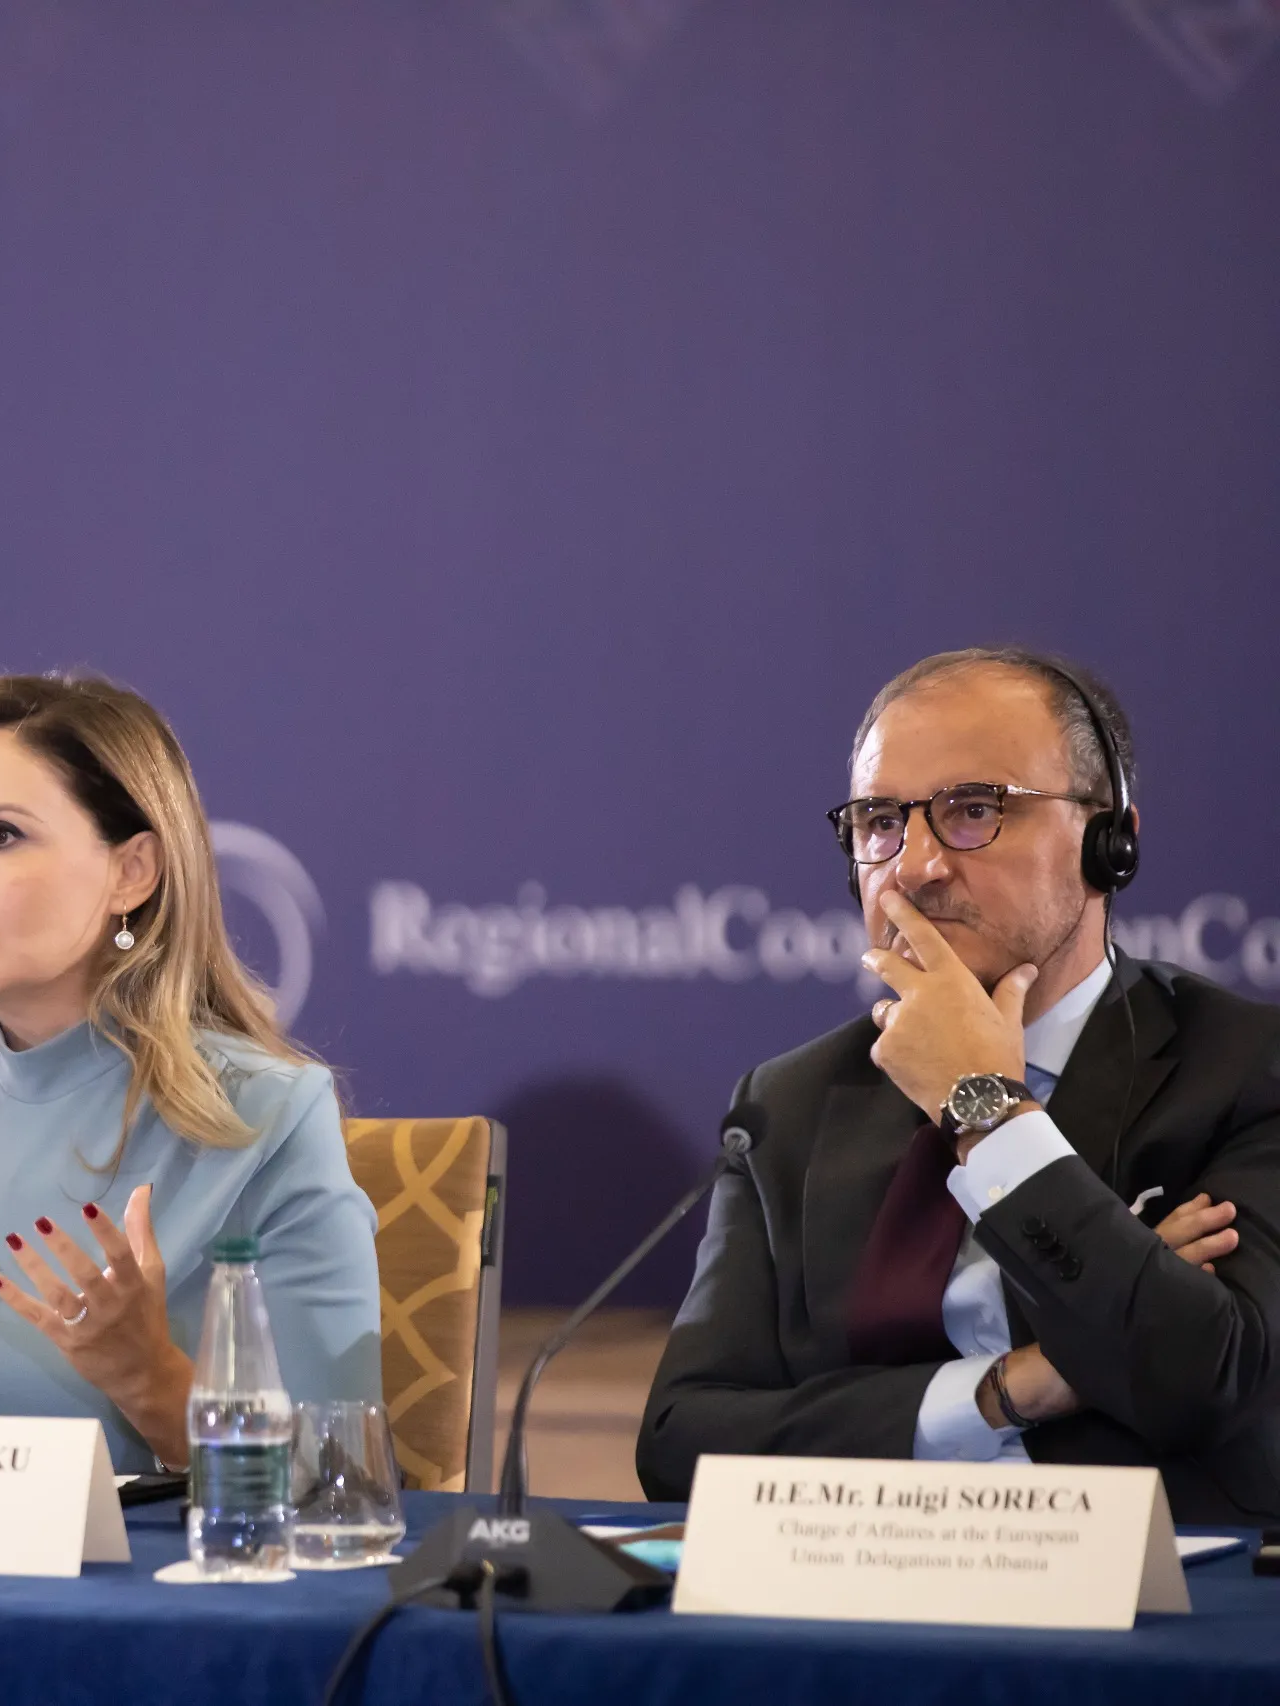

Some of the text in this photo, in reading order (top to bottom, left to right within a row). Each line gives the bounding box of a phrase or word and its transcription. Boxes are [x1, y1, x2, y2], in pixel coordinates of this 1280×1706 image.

[753, 1481, 1093, 1515] H.E.Mr. Luigi SORECA
[468, 1518, 530, 1543] AKG
[778, 1520, 840, 1542] Charge
[941, 1525, 959, 1542] at
[963, 1524, 989, 1543] the
[994, 1526, 1080, 1547] European
[790, 1547, 1049, 1573] Union Delegation to Albania
